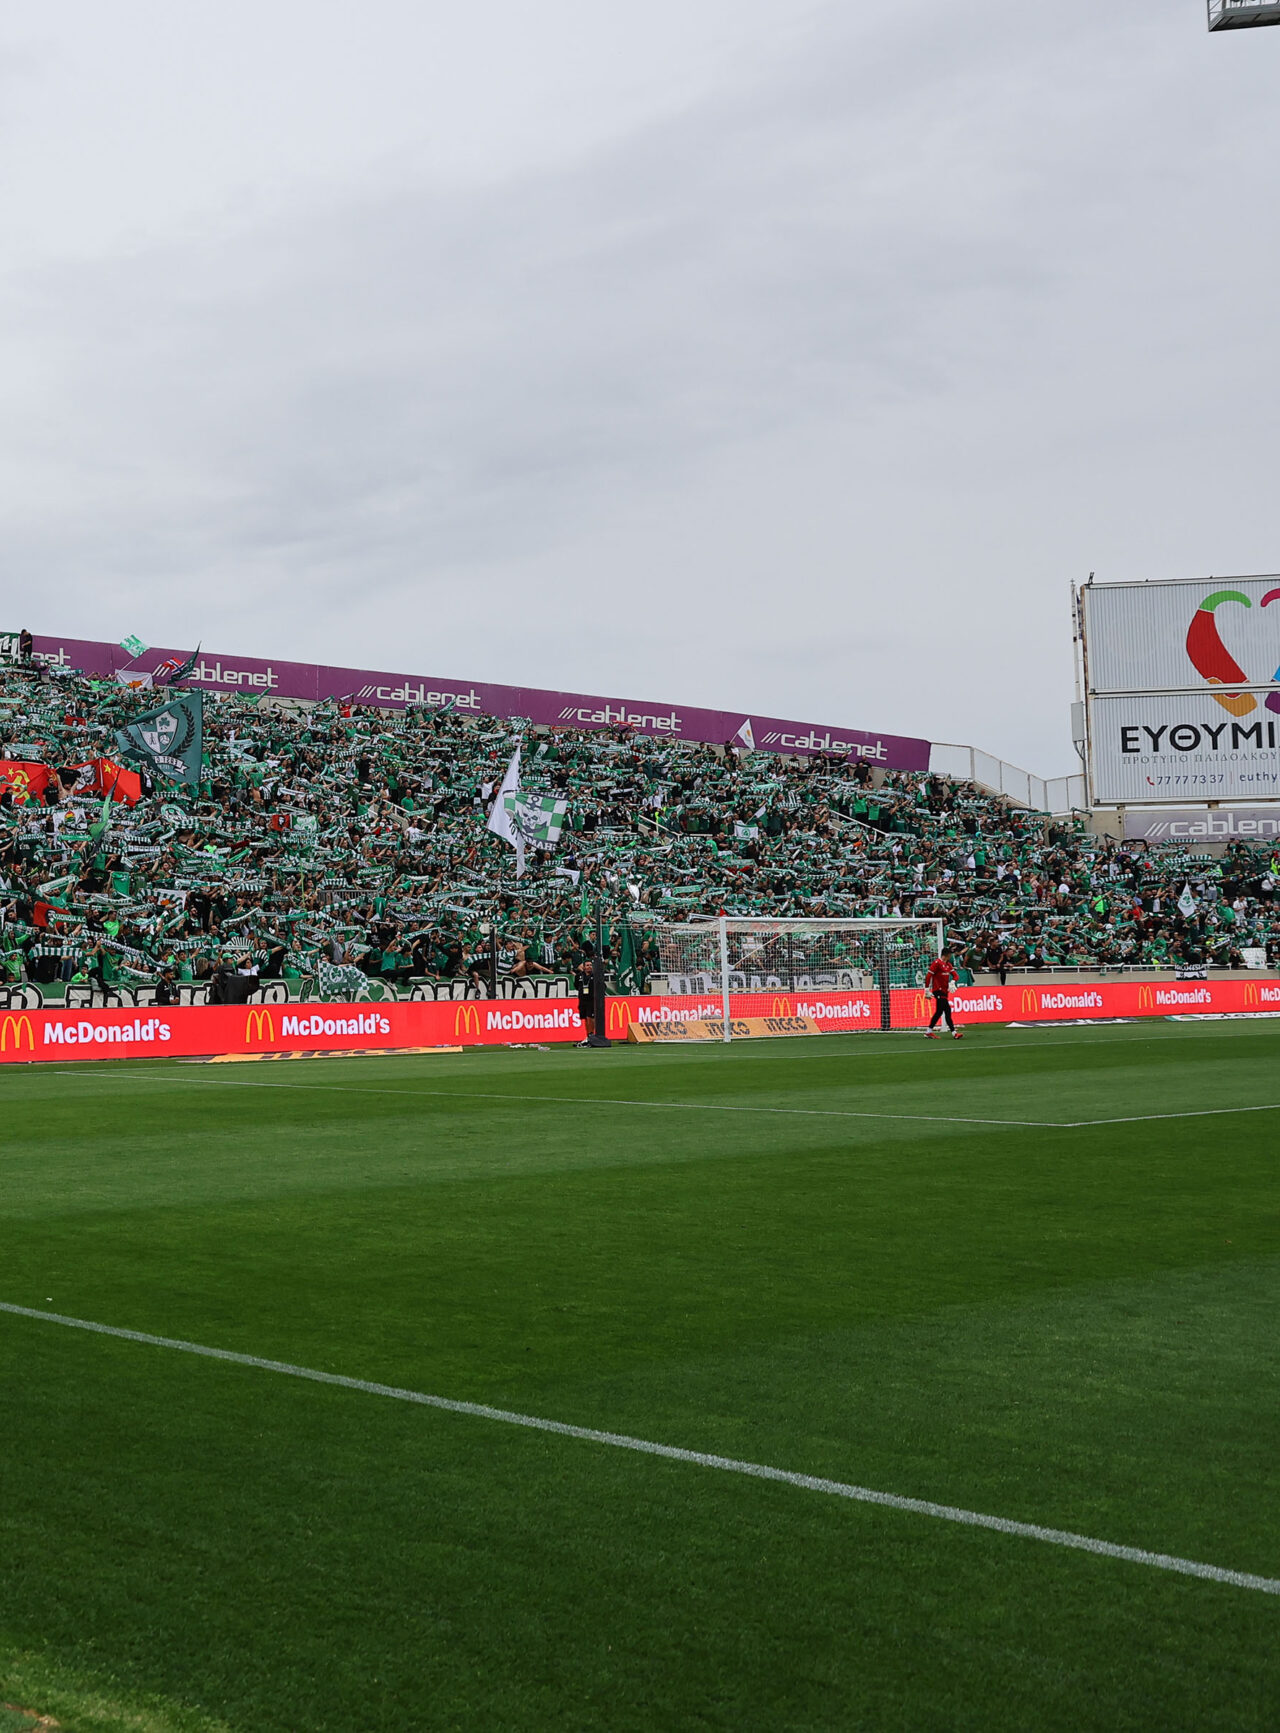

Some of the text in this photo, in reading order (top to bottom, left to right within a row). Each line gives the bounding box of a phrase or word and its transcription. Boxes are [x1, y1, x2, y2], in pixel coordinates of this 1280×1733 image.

[187, 661, 278, 688] ablenet
[376, 682, 481, 709] cablenet
[577, 705, 682, 732] cablenet
[780, 731, 888, 760] cablenet
[1121, 721, 1280, 753] ΕΥΘΥΜΙ
[1170, 813, 1280, 837] cablen
[949, 994, 1003, 1013] cDonald's
[1041, 991, 1103, 1010] McDonald's
[1156, 989, 1212, 1005] McDonald's
[486, 1008, 582, 1031] McDonald's
[797, 1000, 870, 1019] McDonald's
[43, 1018, 171, 1045] McDonald's
[282, 1013, 390, 1037] McDonald's
